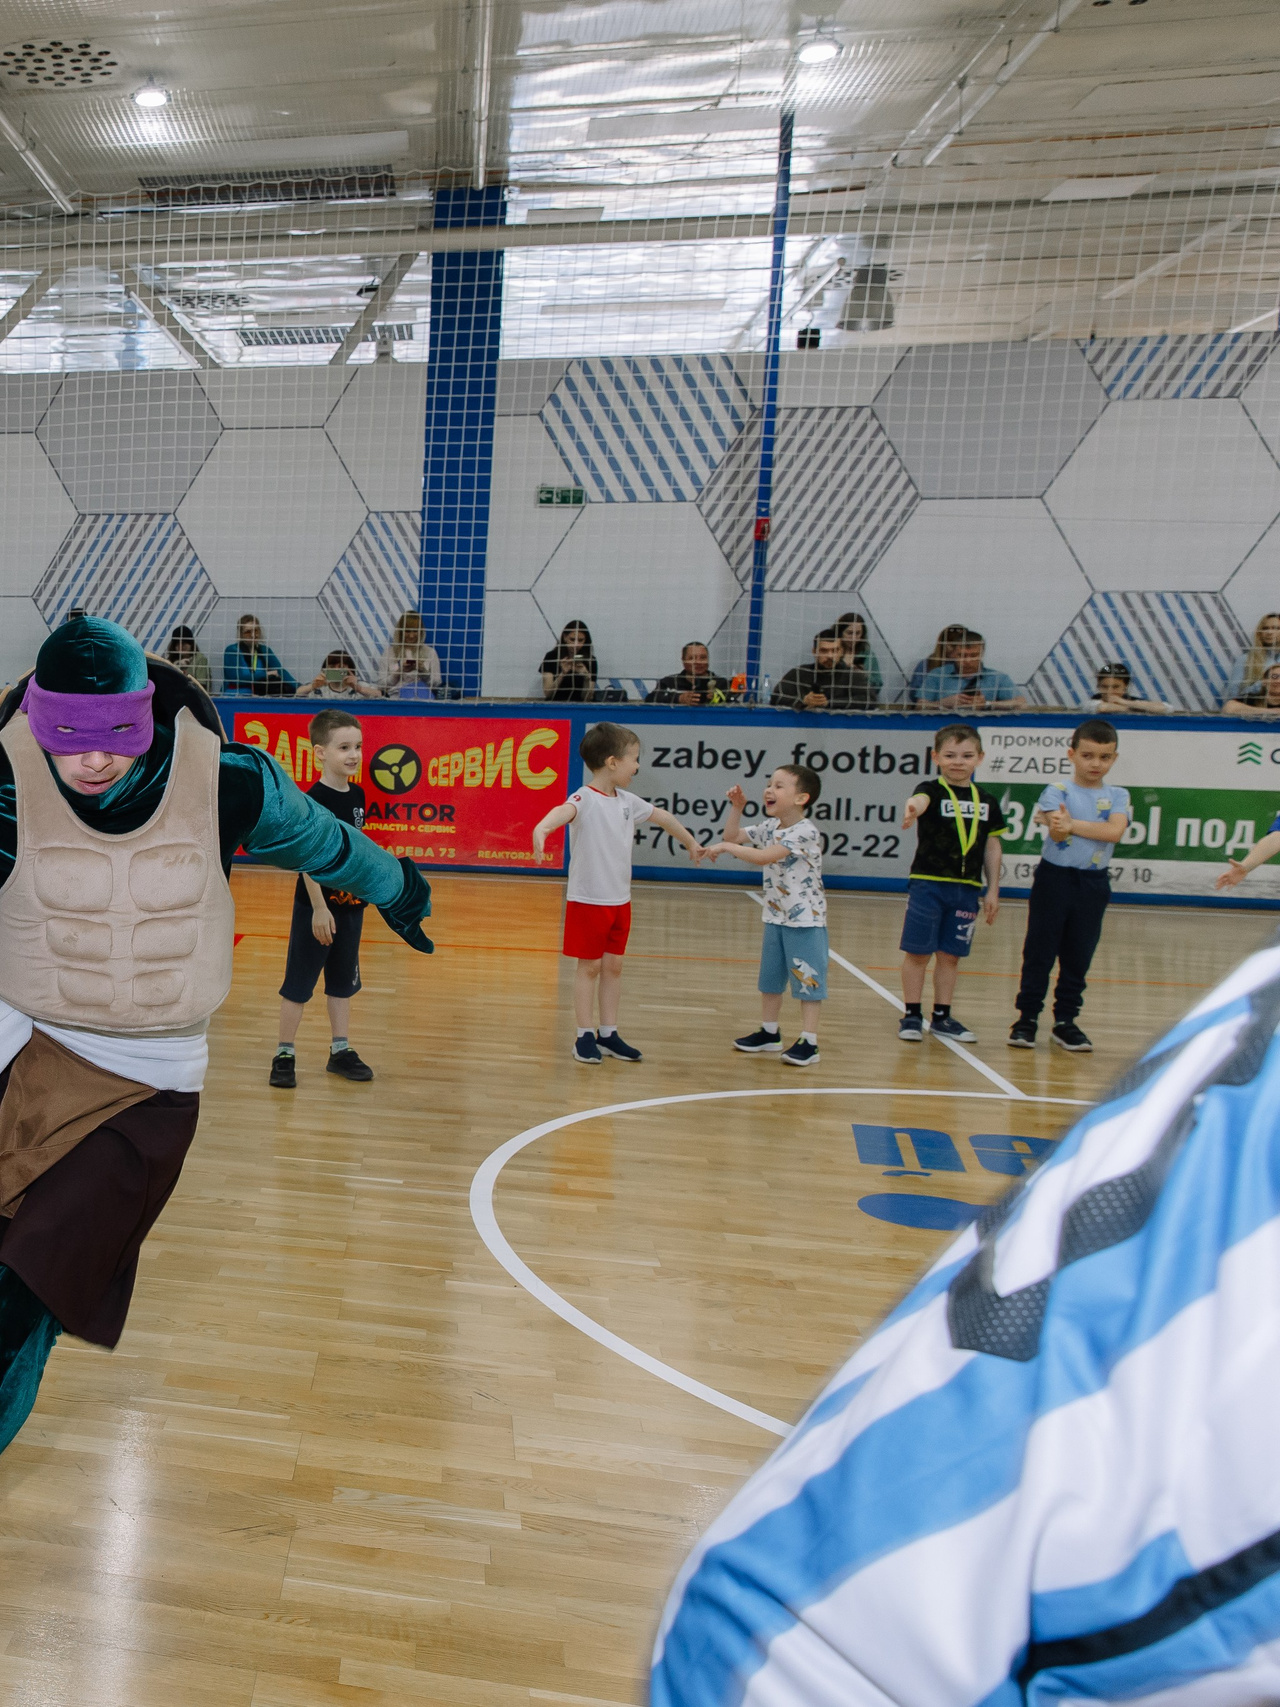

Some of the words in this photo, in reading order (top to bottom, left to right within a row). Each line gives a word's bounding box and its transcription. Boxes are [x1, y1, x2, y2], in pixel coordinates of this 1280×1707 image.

[991, 734, 1072, 749] промок
[428, 728, 560, 790] СЕРВИС
[365, 802, 455, 822] AKTOR
[361, 822, 408, 832] АПЧАСТИ
[1175, 818, 1256, 856] под
[439, 847, 456, 858] 73
